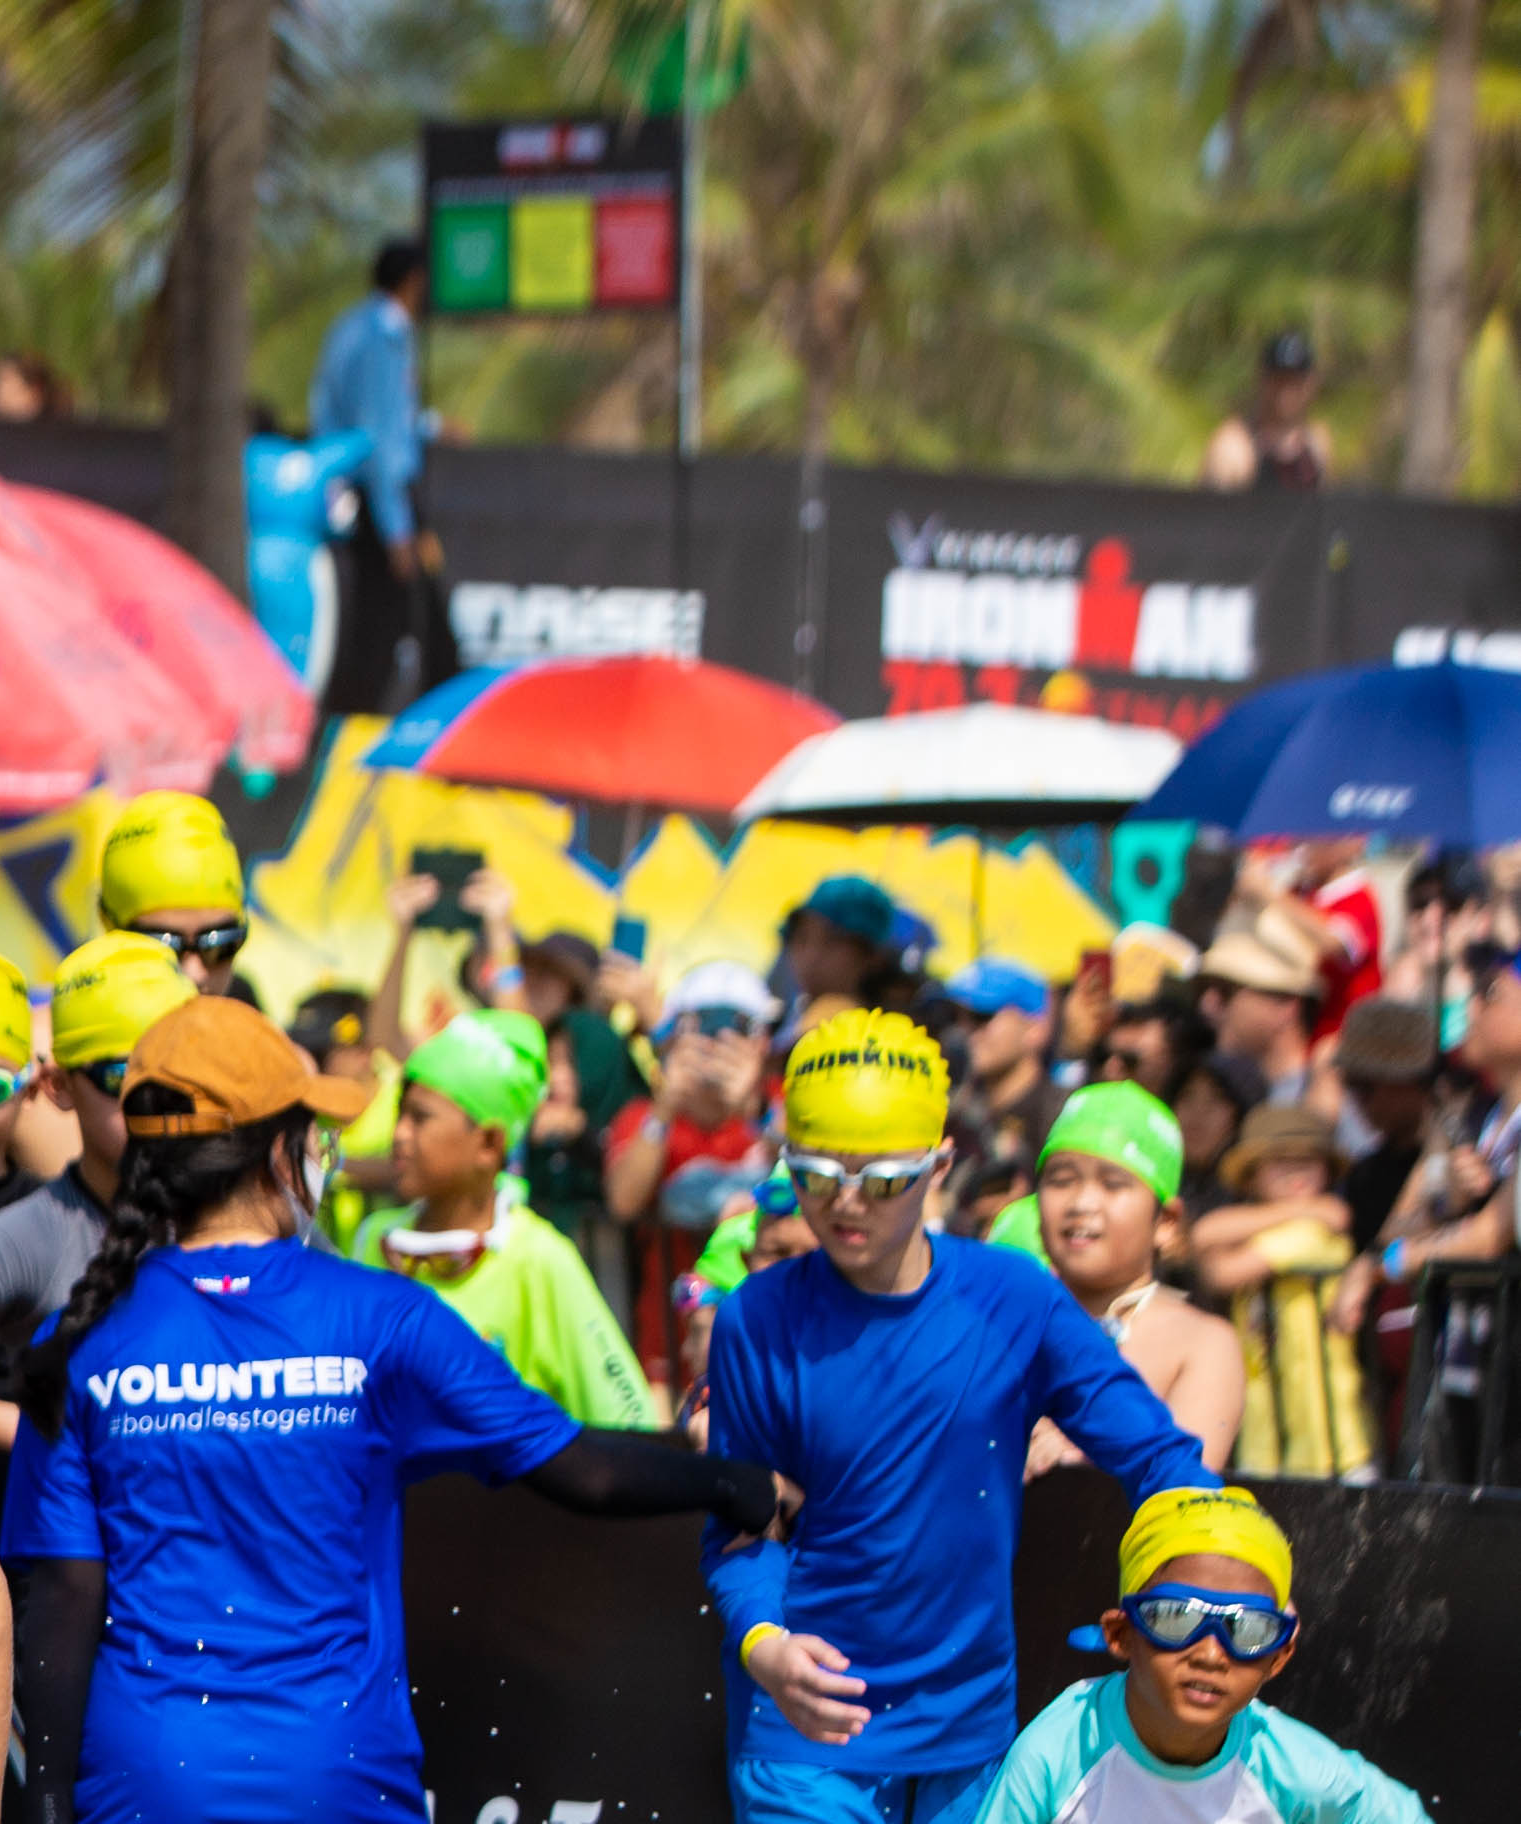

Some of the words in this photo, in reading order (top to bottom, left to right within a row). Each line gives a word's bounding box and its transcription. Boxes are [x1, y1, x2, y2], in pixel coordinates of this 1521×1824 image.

[883, 540, 1255, 680] IRONMAN
[88, 1356, 369, 1409] VOLUNTEER
[109, 1402, 358, 1436] #boundlesstogether
